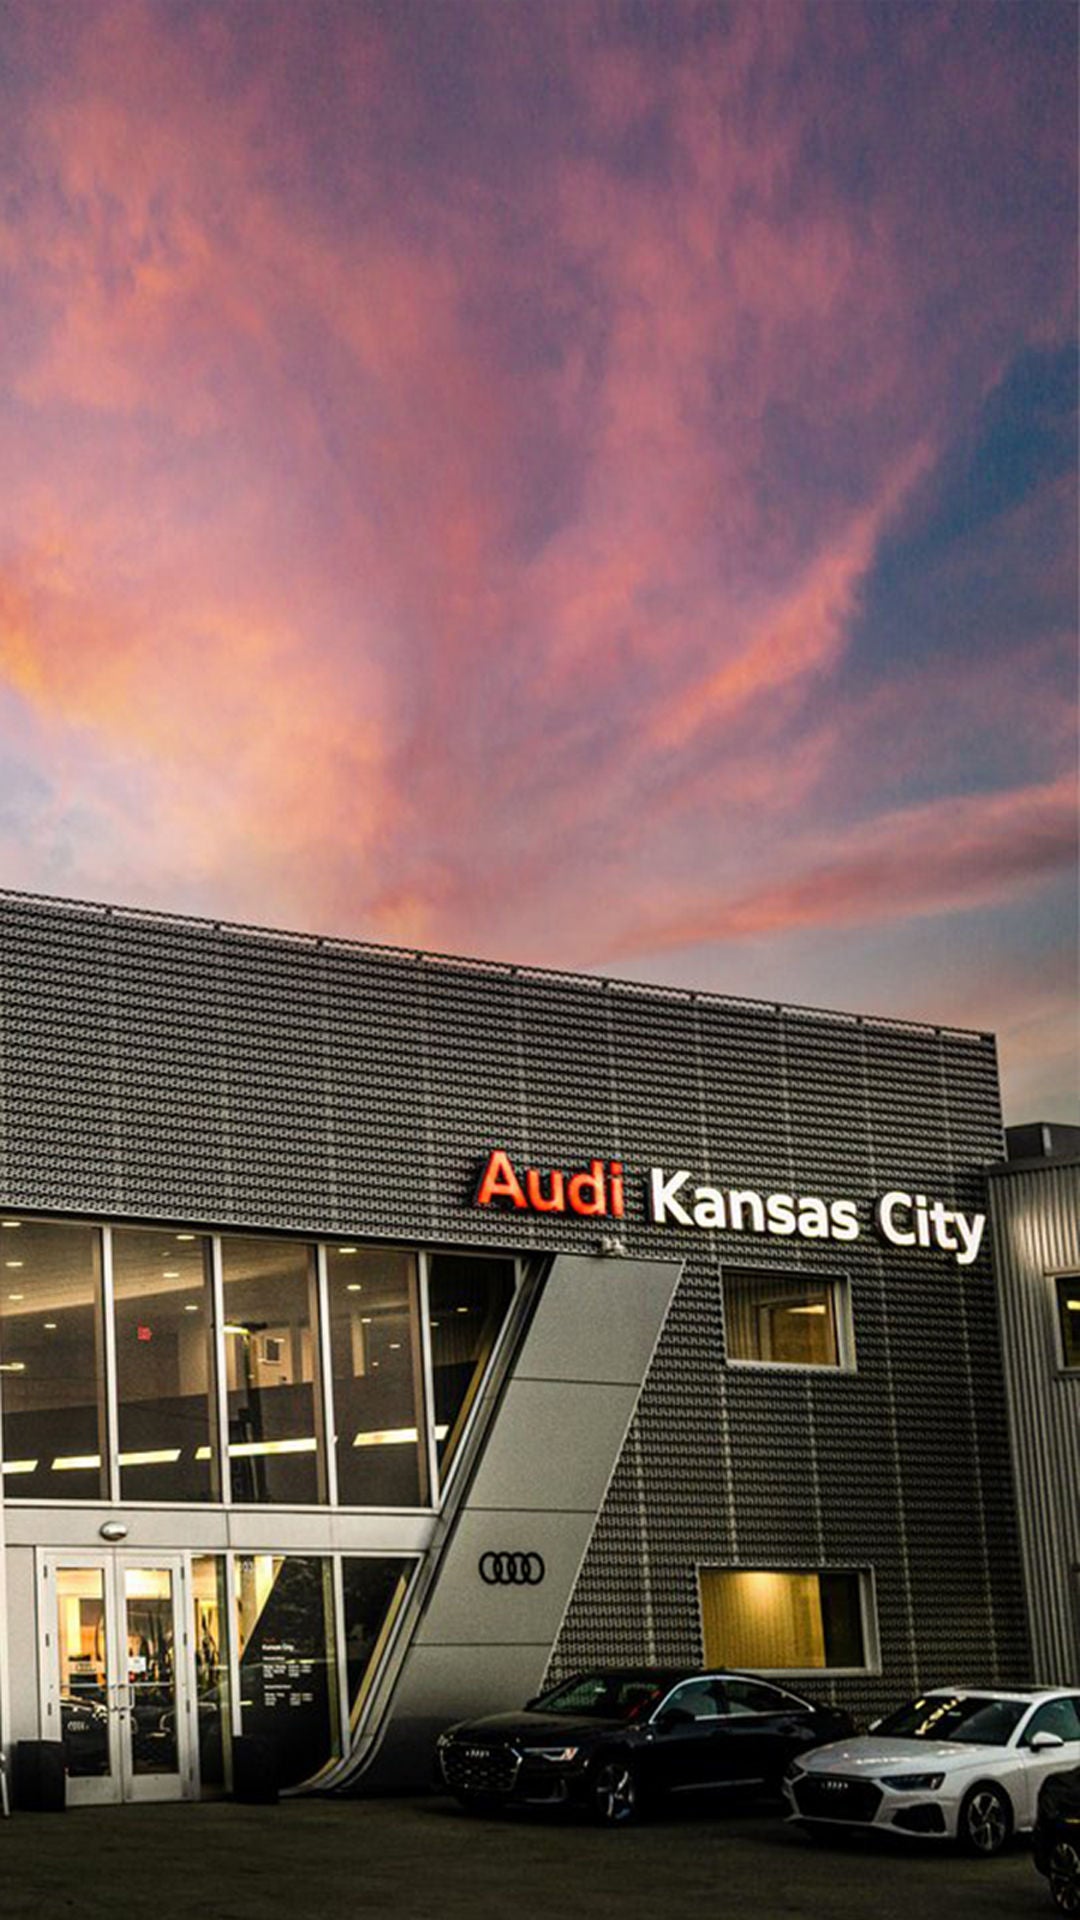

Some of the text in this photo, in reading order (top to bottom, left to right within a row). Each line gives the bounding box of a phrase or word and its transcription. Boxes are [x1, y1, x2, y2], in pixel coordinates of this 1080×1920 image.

[477, 1150, 985, 1264] Audi Kansas City
